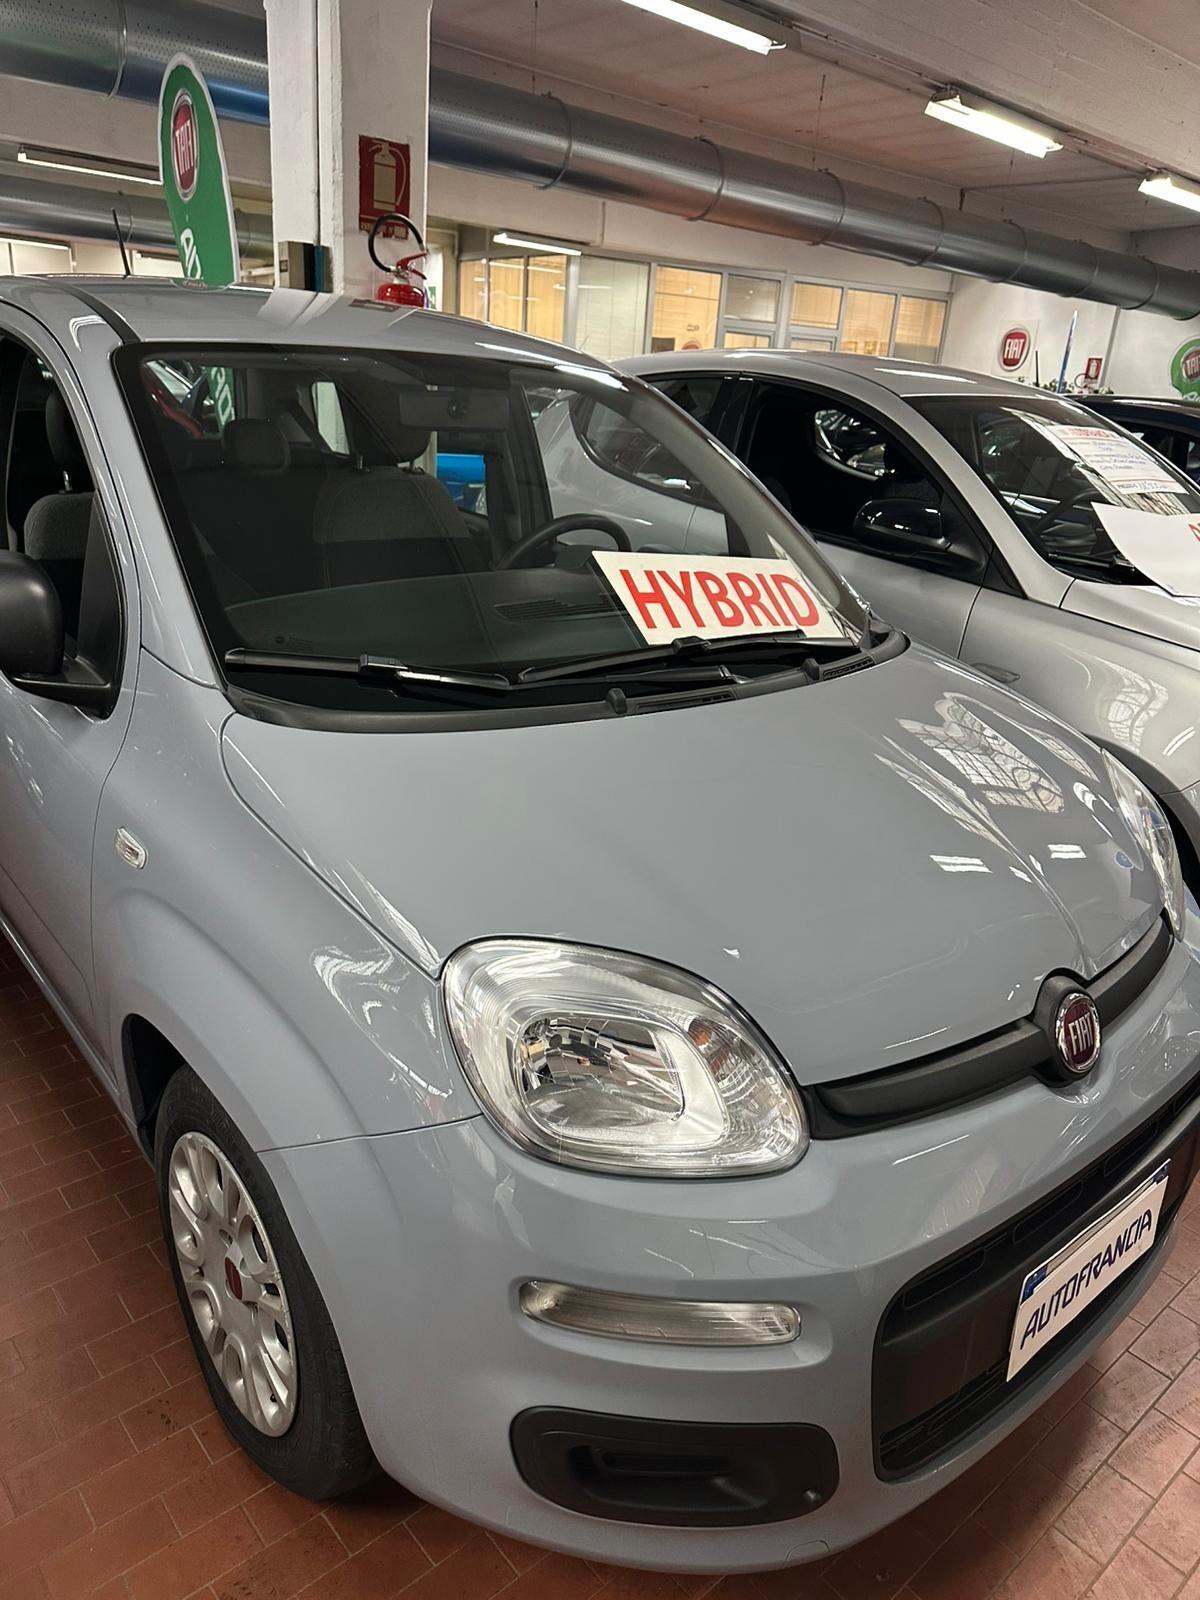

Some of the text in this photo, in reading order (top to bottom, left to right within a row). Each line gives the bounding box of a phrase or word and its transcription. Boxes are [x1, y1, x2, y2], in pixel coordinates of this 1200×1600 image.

[1004, 338, 1025, 359] FIAT
[619, 569, 820, 629] HYBRID
[1068, 1012, 1094, 1056] FIAT
[1020, 1208, 1152, 1350] AUTOFRANCIA
